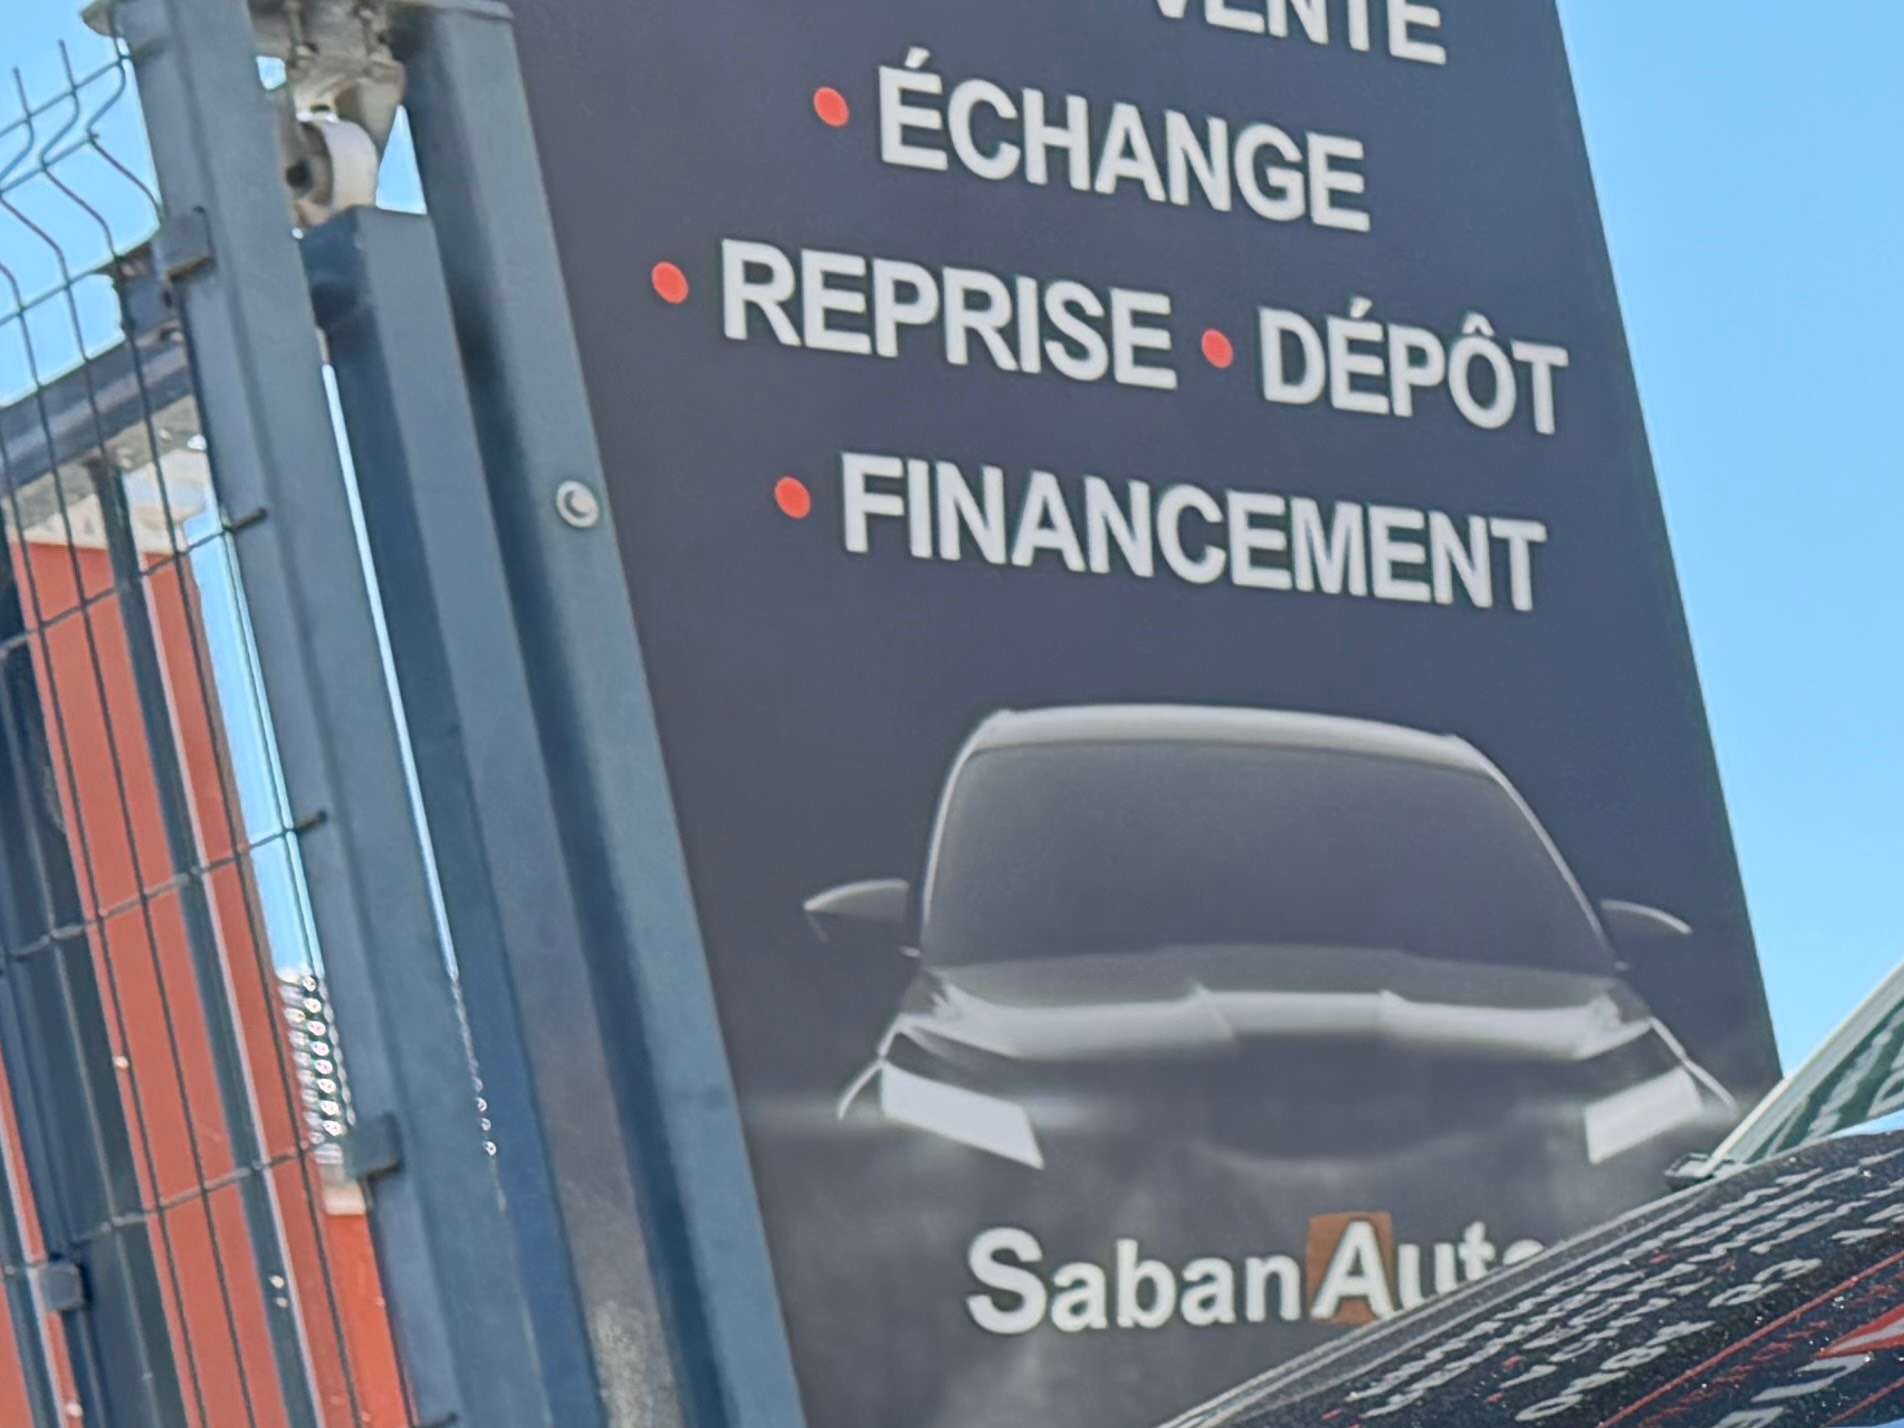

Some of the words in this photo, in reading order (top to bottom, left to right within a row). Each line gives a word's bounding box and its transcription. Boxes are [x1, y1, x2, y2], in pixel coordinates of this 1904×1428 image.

[1158, 0, 1447, 65] NTE
[878, 48, 1373, 233] ÉCHANGE
[720, 239, 1178, 391] REPRISE
[1258, 298, 1569, 435] DÉPÔT
[841, 451, 1548, 612] FINANCEMENT
